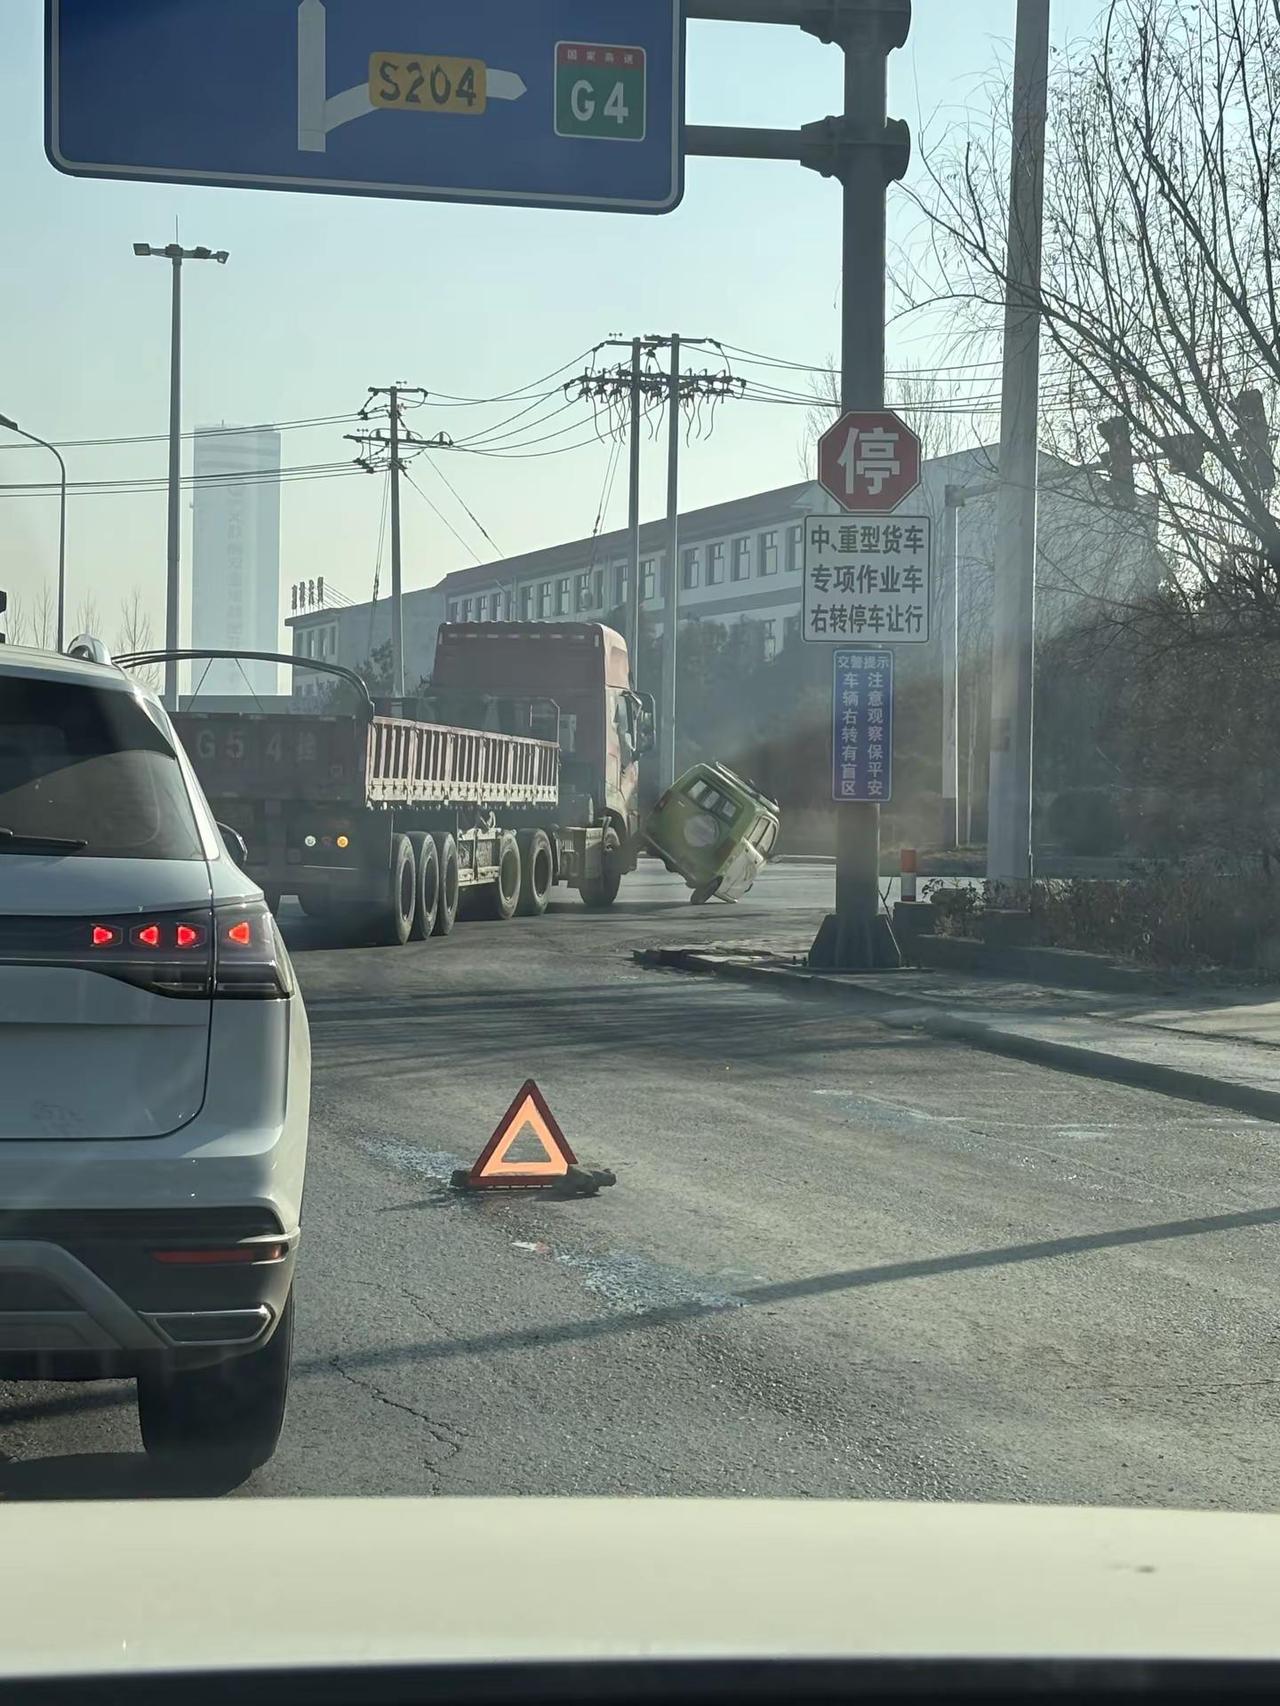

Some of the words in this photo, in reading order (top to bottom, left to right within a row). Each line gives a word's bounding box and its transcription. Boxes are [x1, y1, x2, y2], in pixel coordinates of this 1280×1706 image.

[379, 60, 477, 107] S204
[570, 79, 630, 124] G4
[836, 426, 901, 495] 停
[810, 523, 924, 555] 中、重型货车
[810, 563, 924, 594] 专项作业车
[810, 603, 924, 634] 右转停车让行
[837, 655, 890, 670] 交警提示
[840, 672, 860, 797] 车辆右转有盲区
[866, 672, 884, 796] 注意观察保平安
